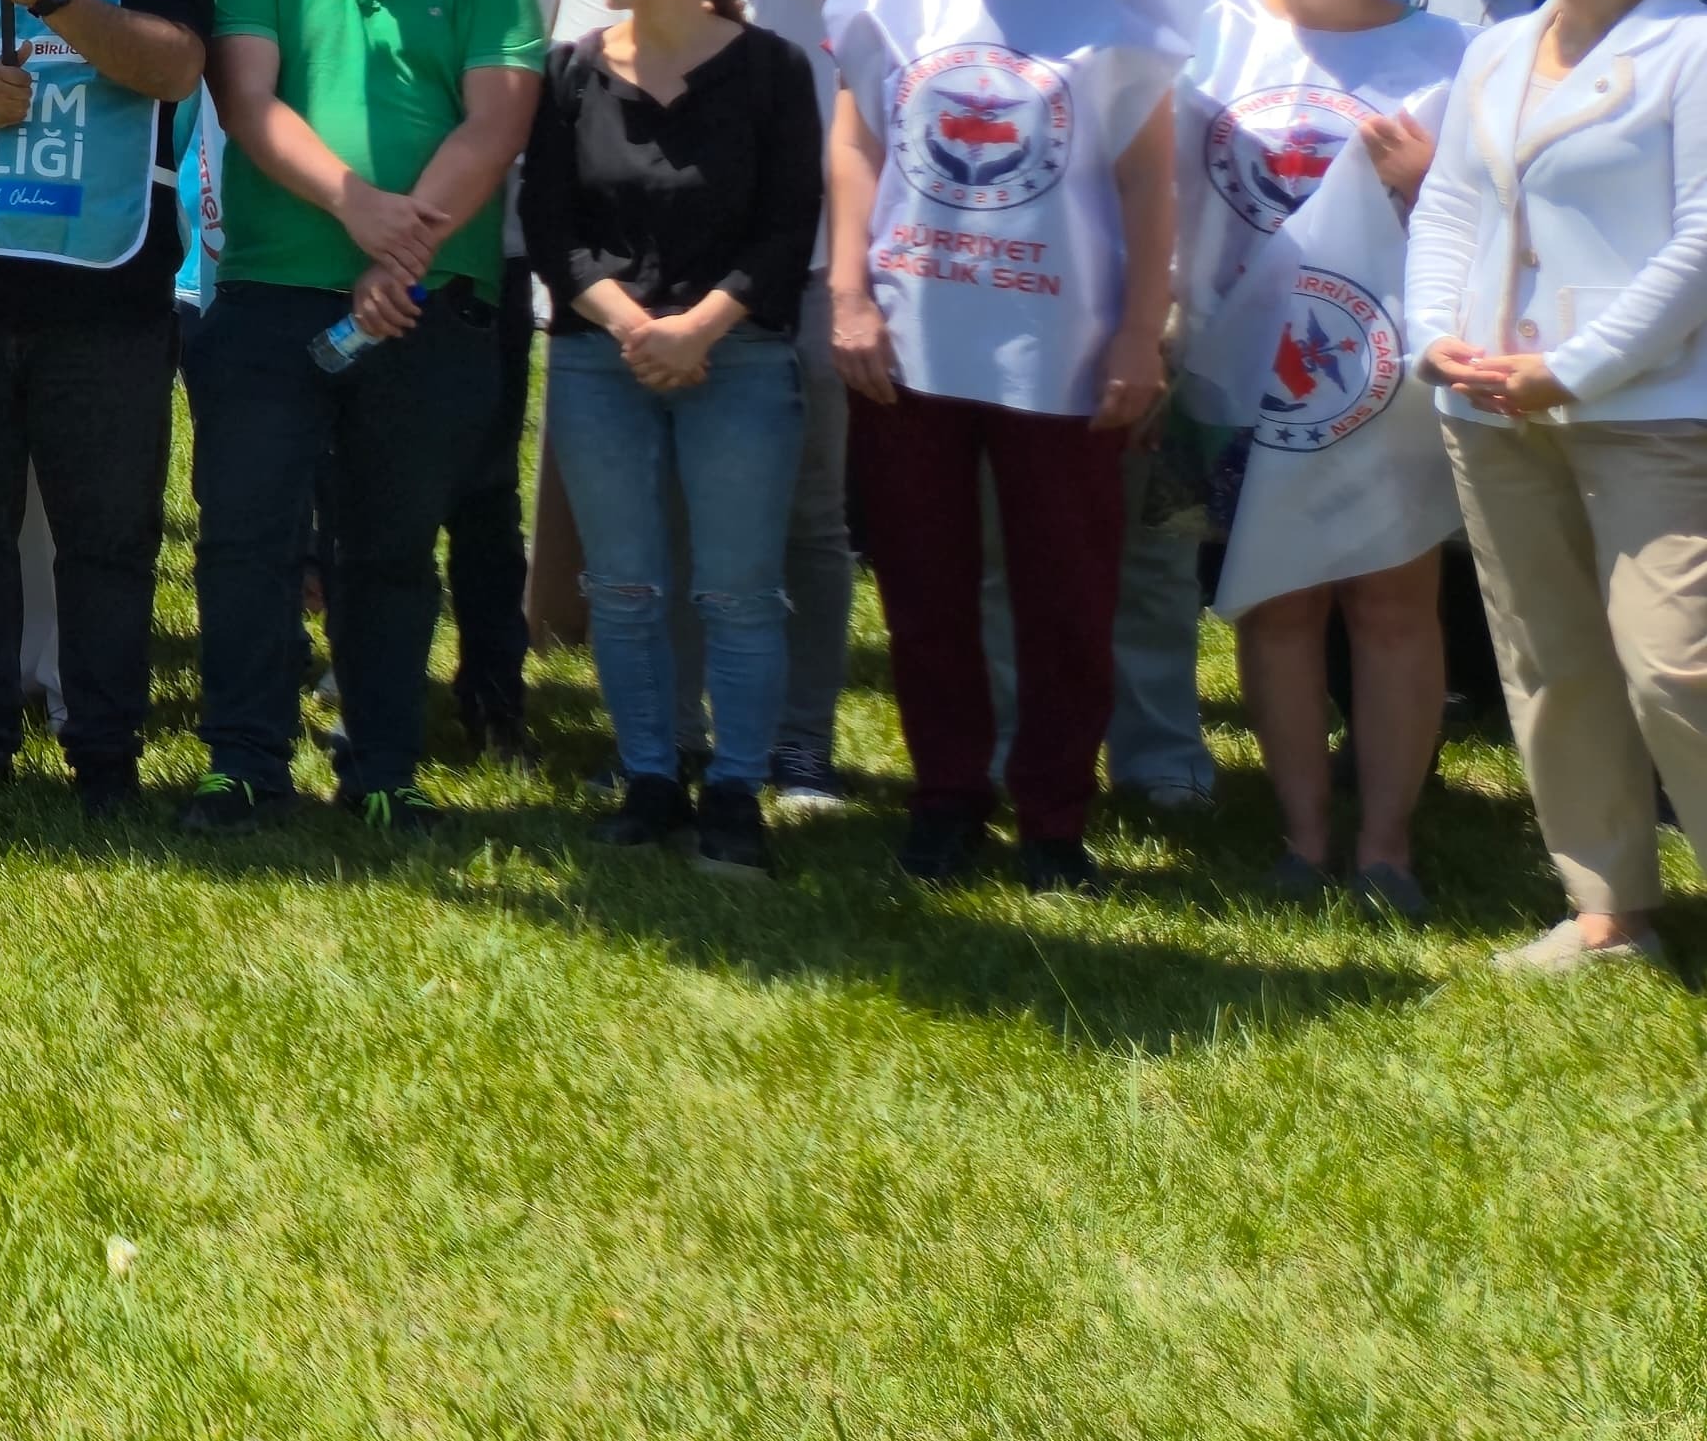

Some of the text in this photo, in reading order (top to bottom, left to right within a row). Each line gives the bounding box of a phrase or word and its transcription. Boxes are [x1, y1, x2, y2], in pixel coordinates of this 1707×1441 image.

[931, 180, 1010, 203] 2022
[892, 223, 1048, 264] HÜRRİYET
[992, 266, 1061, 298] SEN
[1369, 328, 1398, 401] SAĞLIK
